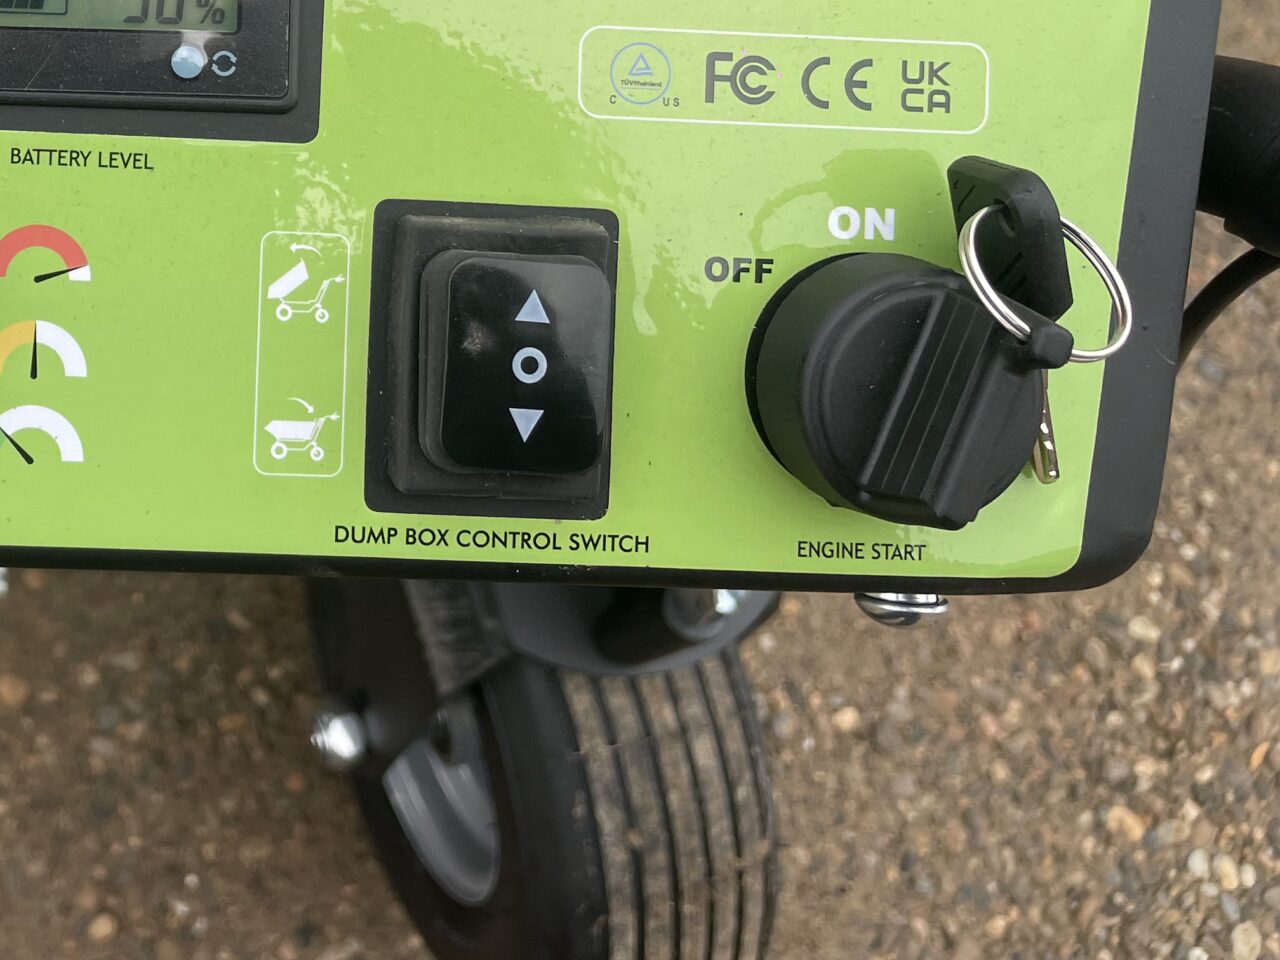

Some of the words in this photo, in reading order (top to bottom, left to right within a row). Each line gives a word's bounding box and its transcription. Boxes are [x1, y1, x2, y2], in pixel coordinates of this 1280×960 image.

[901, 59, 952, 87] UK
[900, 87, 951, 114] CA
[10, 147, 92, 168] BATTERY
[98, 151, 154, 170] LEVEL
[827, 205, 896, 241] ON
[704, 256, 775, 284] OFF
[334, 525, 398, 545] DUMP
[405, 527, 450, 547] BOX
[456, 529, 562, 551] CONTROL
[568, 533, 650, 553] SWITCH
[797, 540, 866, 560] ENGINE
[871, 542, 927, 562] START
